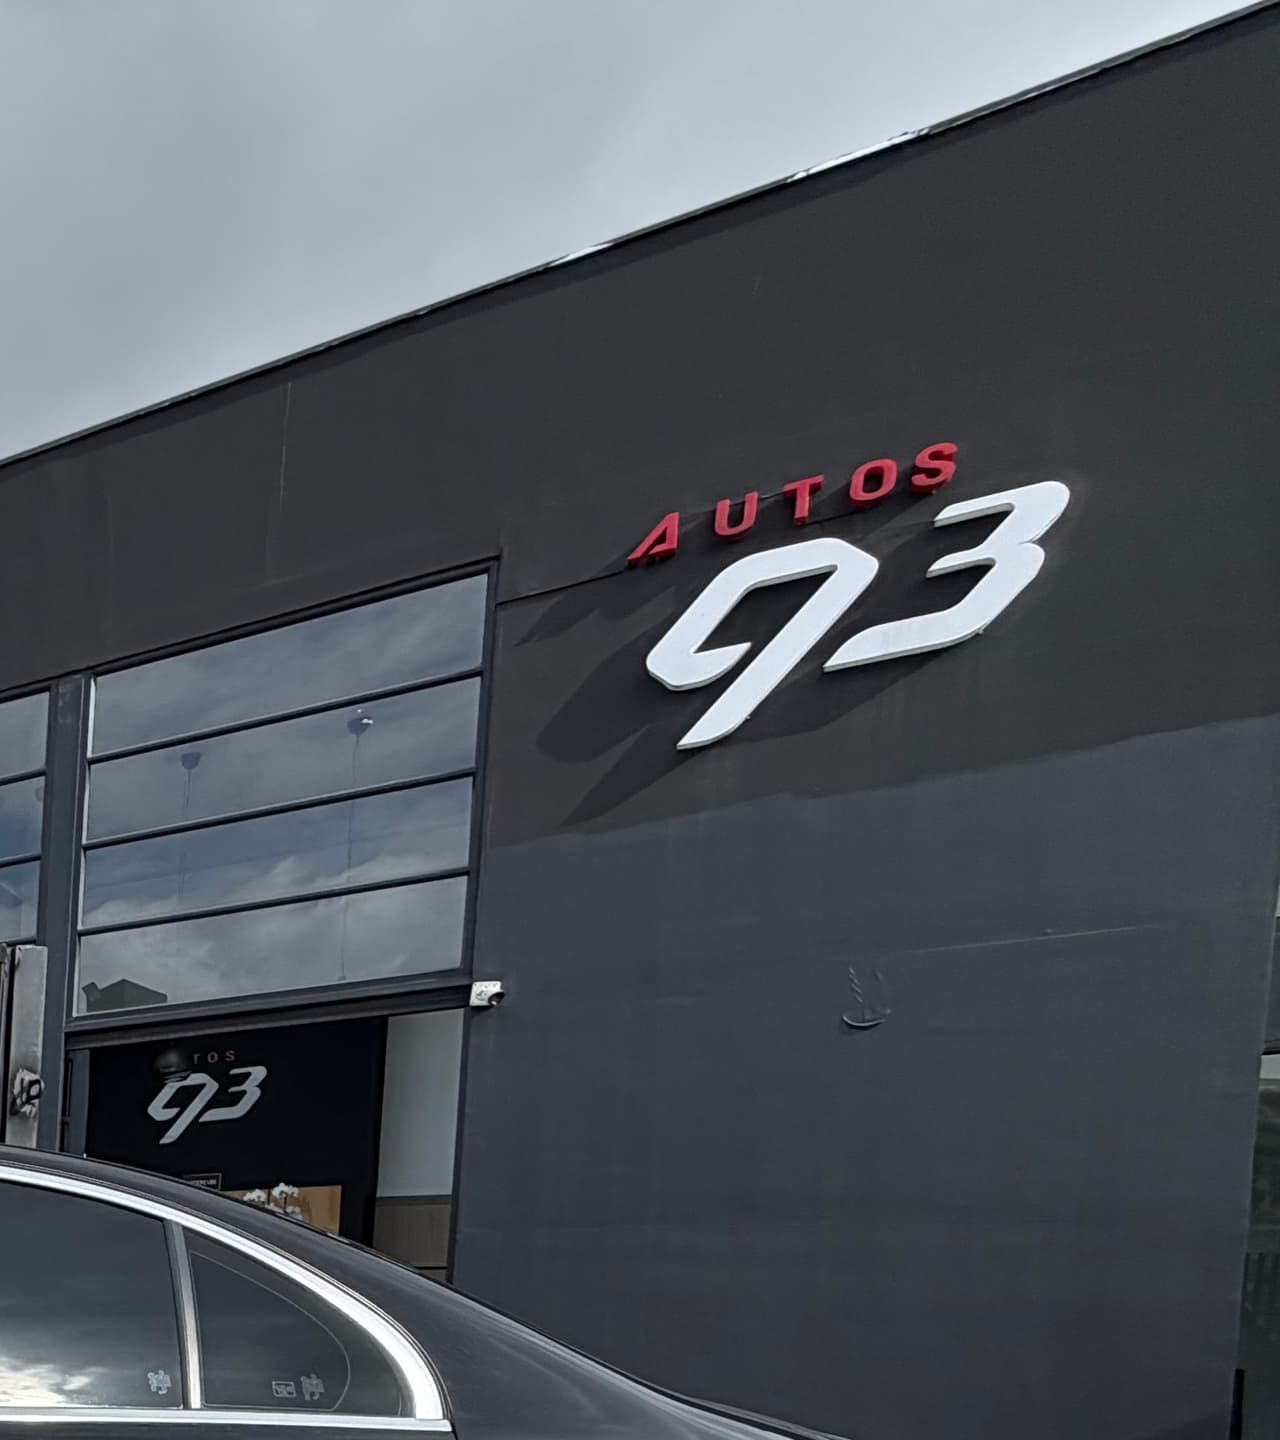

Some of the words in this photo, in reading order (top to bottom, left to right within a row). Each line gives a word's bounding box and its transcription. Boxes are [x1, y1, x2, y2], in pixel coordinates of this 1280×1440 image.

[627, 442, 959, 567] AUTOS
[646, 481, 1071, 750] 93
[147, 1065, 268, 1145] 93
